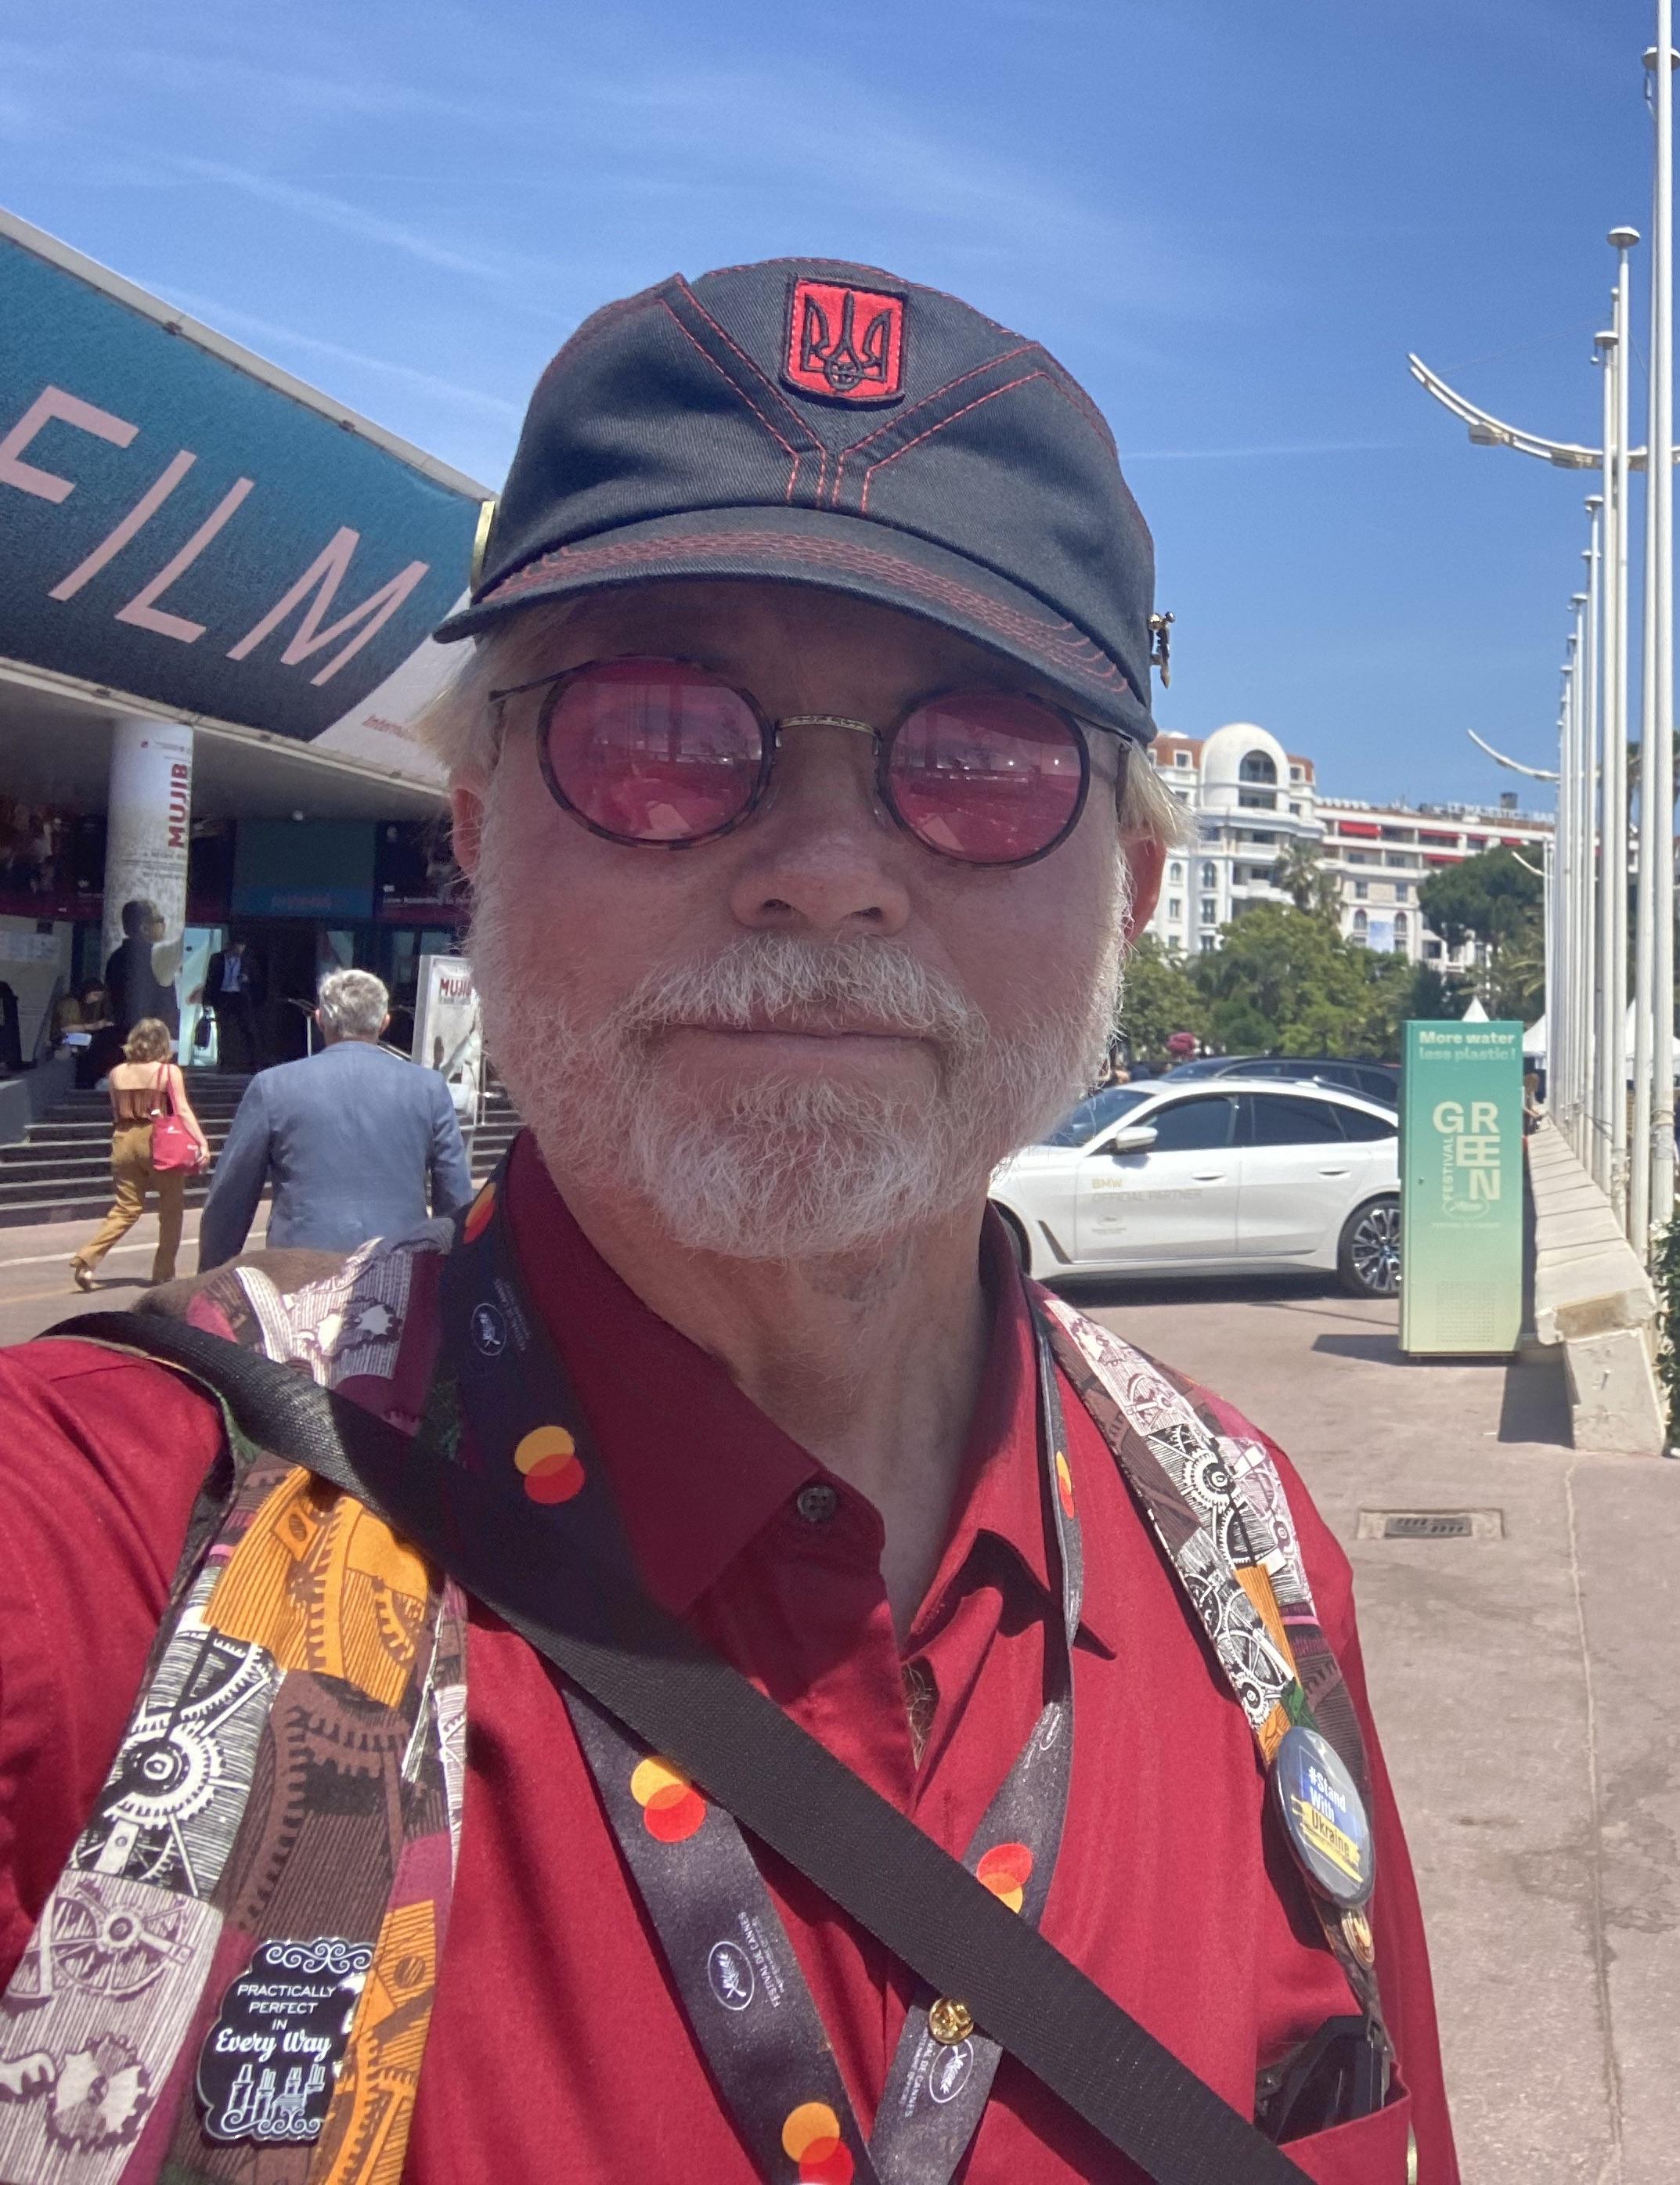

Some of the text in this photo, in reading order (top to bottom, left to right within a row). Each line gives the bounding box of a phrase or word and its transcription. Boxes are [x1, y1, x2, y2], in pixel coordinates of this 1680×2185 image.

[0, 384, 430, 687] FILM
[168, 763, 189, 849] MUJIB
[1419, 1031, 1516, 1044] More water
[1419, 1047, 1451, 1060] less
[1092, 1178, 1123, 1189] BMW
[1442, 1137, 1454, 1202] FESTIVAL
[1309, 1765, 1347, 1813] #Stand
[1310, 1786, 1335, 1823] With
[1312, 1808, 1350, 1855] Ukraine
[738, 1911, 759, 1950] CANNES
[752, 1949, 764, 1965] DE
[237, 1984, 337, 1998] PRACTICALLY
[759, 1964, 781, 2008] FESTIVAL
[249, 2001, 319, 2014] PERFECT
[272, 2018, 288, 2031] IN
[215, 2028, 332, 2063] Every Way
[905, 2075, 925, 2118] CANNES
